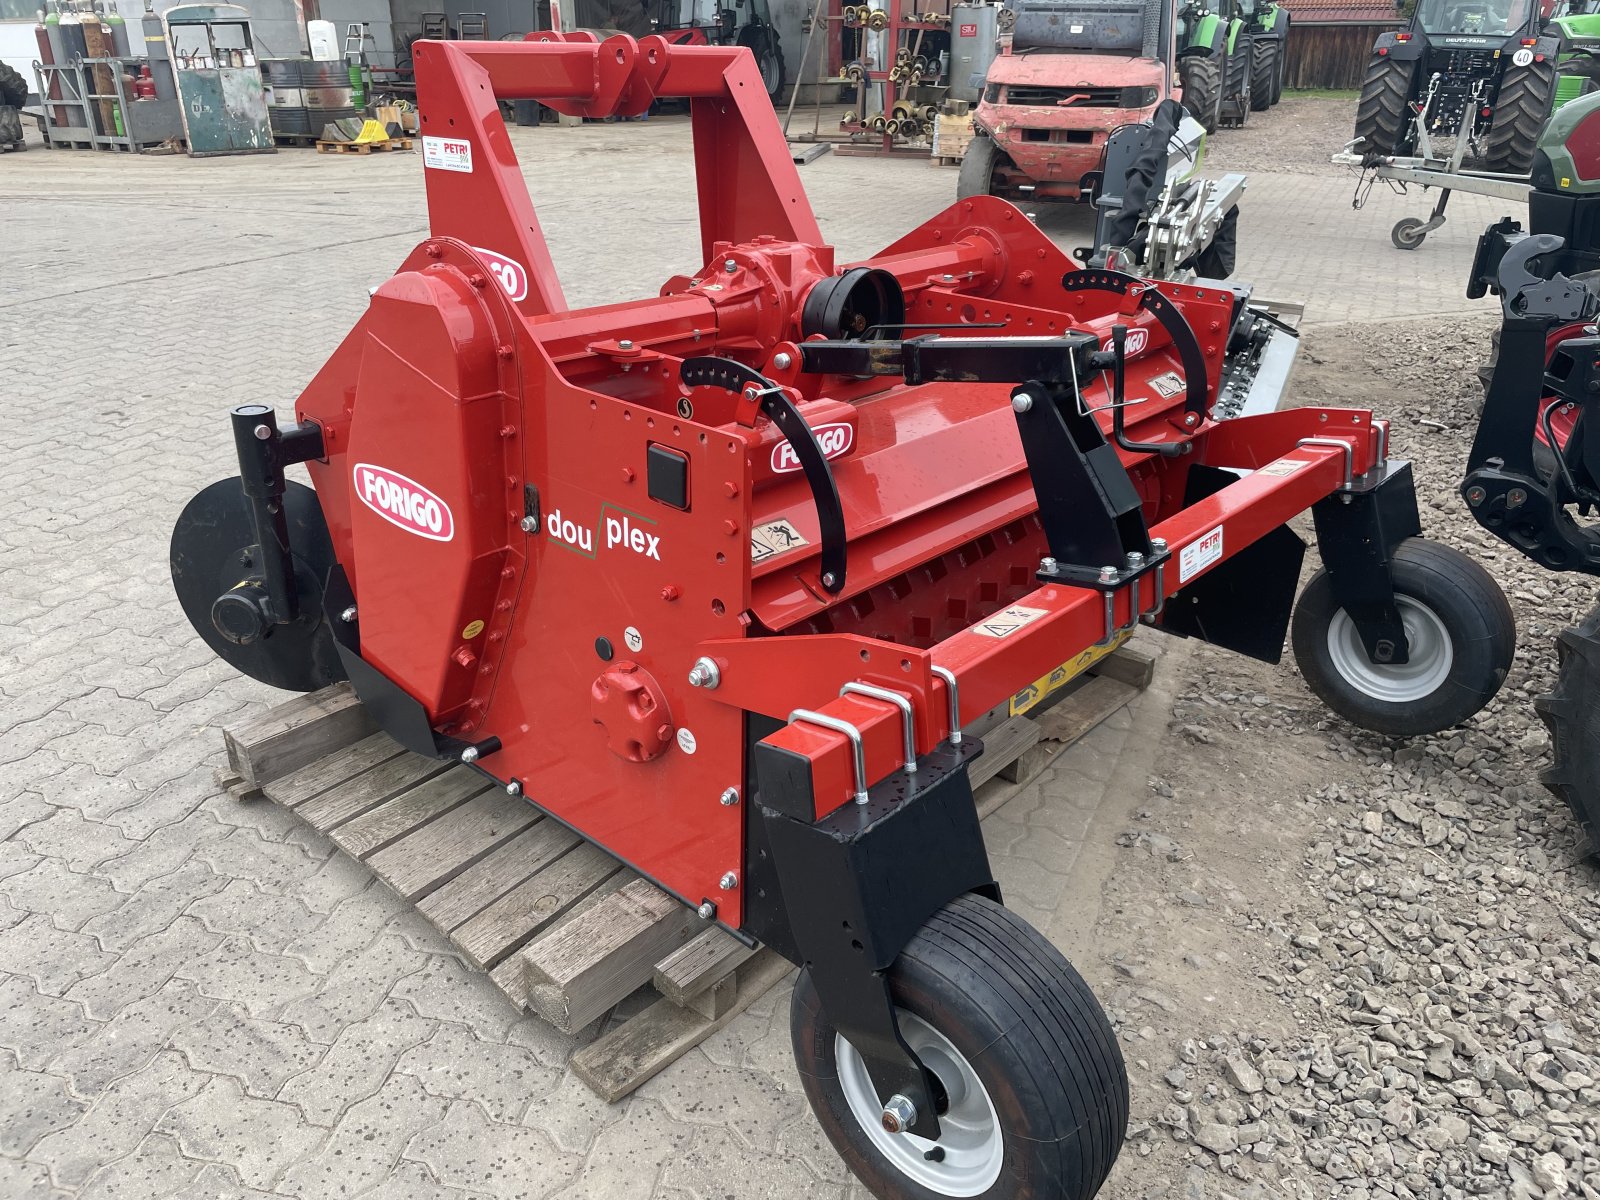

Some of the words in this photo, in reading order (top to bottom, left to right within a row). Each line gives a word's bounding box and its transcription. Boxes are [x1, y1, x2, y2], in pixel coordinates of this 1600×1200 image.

[1516, 52, 1530, 63] 40
[444, 142, 468, 155] PETRI
[1107, 331, 1144, 355] FIGO
[780, 427, 845, 469] FIGO
[363, 469, 442, 533] FORIGO
[547, 508, 592, 552] dou
[606, 516, 661, 561] plex
[1199, 530, 1221, 553] PETRI
